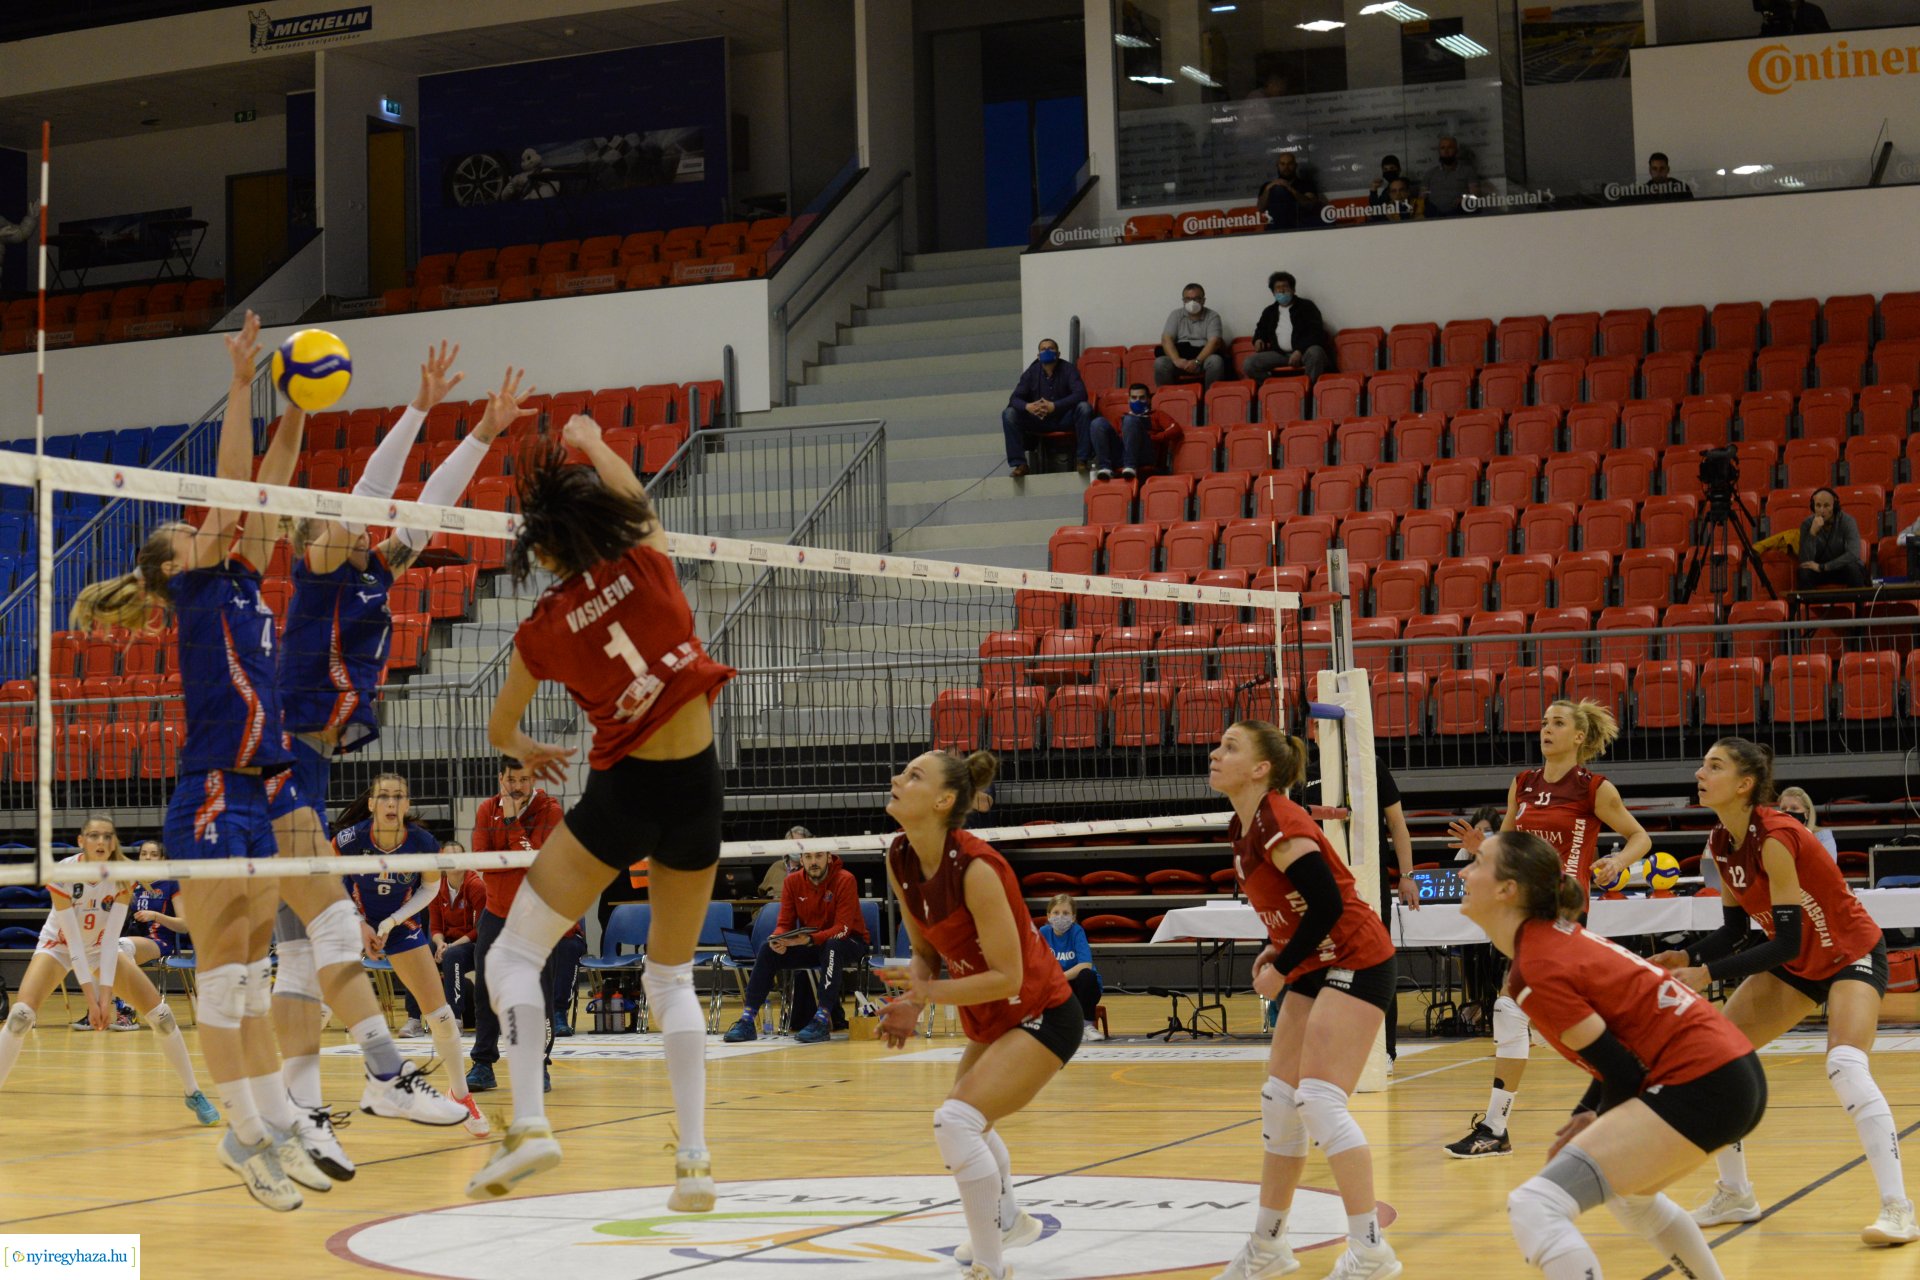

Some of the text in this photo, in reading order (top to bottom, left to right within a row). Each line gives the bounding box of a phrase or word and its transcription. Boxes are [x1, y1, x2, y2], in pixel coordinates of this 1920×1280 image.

[273, 11, 368, 37] MICHELIN
[1461, 189, 1542, 212] Continental
[1604, 180, 1688, 200] Continental
[1320, 199, 1399, 223] Continental
[1050, 222, 1126, 245] Continental
[1183, 211, 1261, 235] Continental
[178, 477, 207, 497] FATUM
[316, 494, 343, 510] FATUM
[566, 574, 634, 634] VASILEVA
[260, 617, 272, 657] 4
[603, 621, 649, 678] 1
[1534, 791, 1551, 806] 11
[204, 821, 219, 845] 4
[1728, 865, 1747, 888] 12
[377, 883, 391, 896] 6
[83, 913, 96, 931] 9
